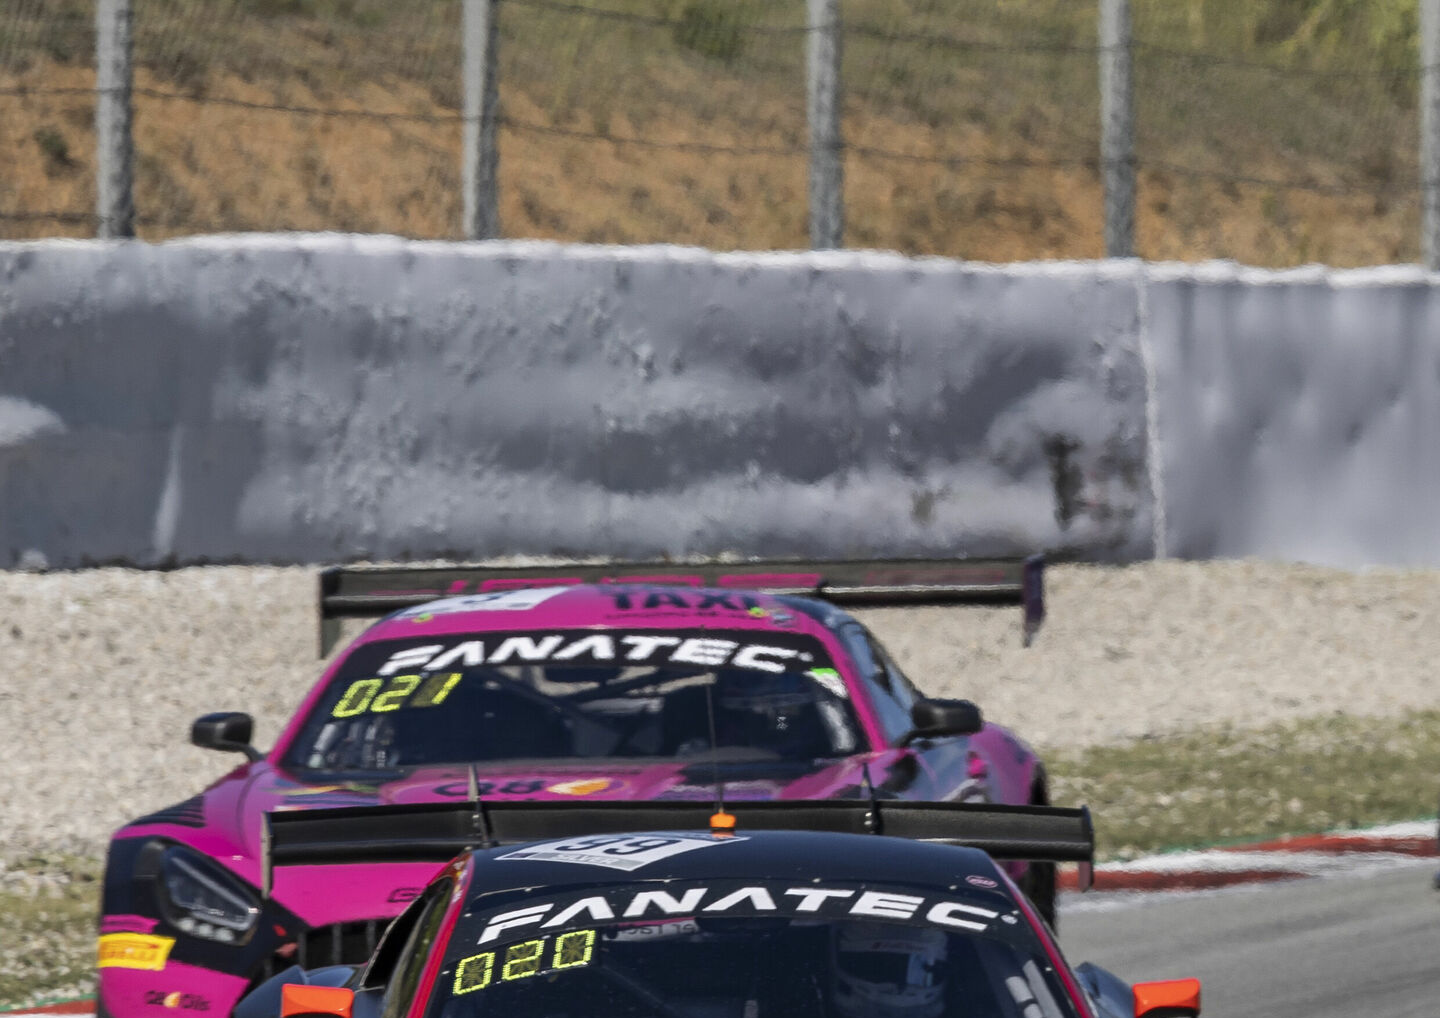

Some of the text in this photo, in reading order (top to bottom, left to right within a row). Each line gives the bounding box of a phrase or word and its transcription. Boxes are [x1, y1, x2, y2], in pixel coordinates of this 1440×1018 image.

[376, 633, 805, 677] FANATEC
[331, 672, 463, 719] 021
[476, 887, 1000, 946] FANATEC
[452, 929, 597, 996] 020
